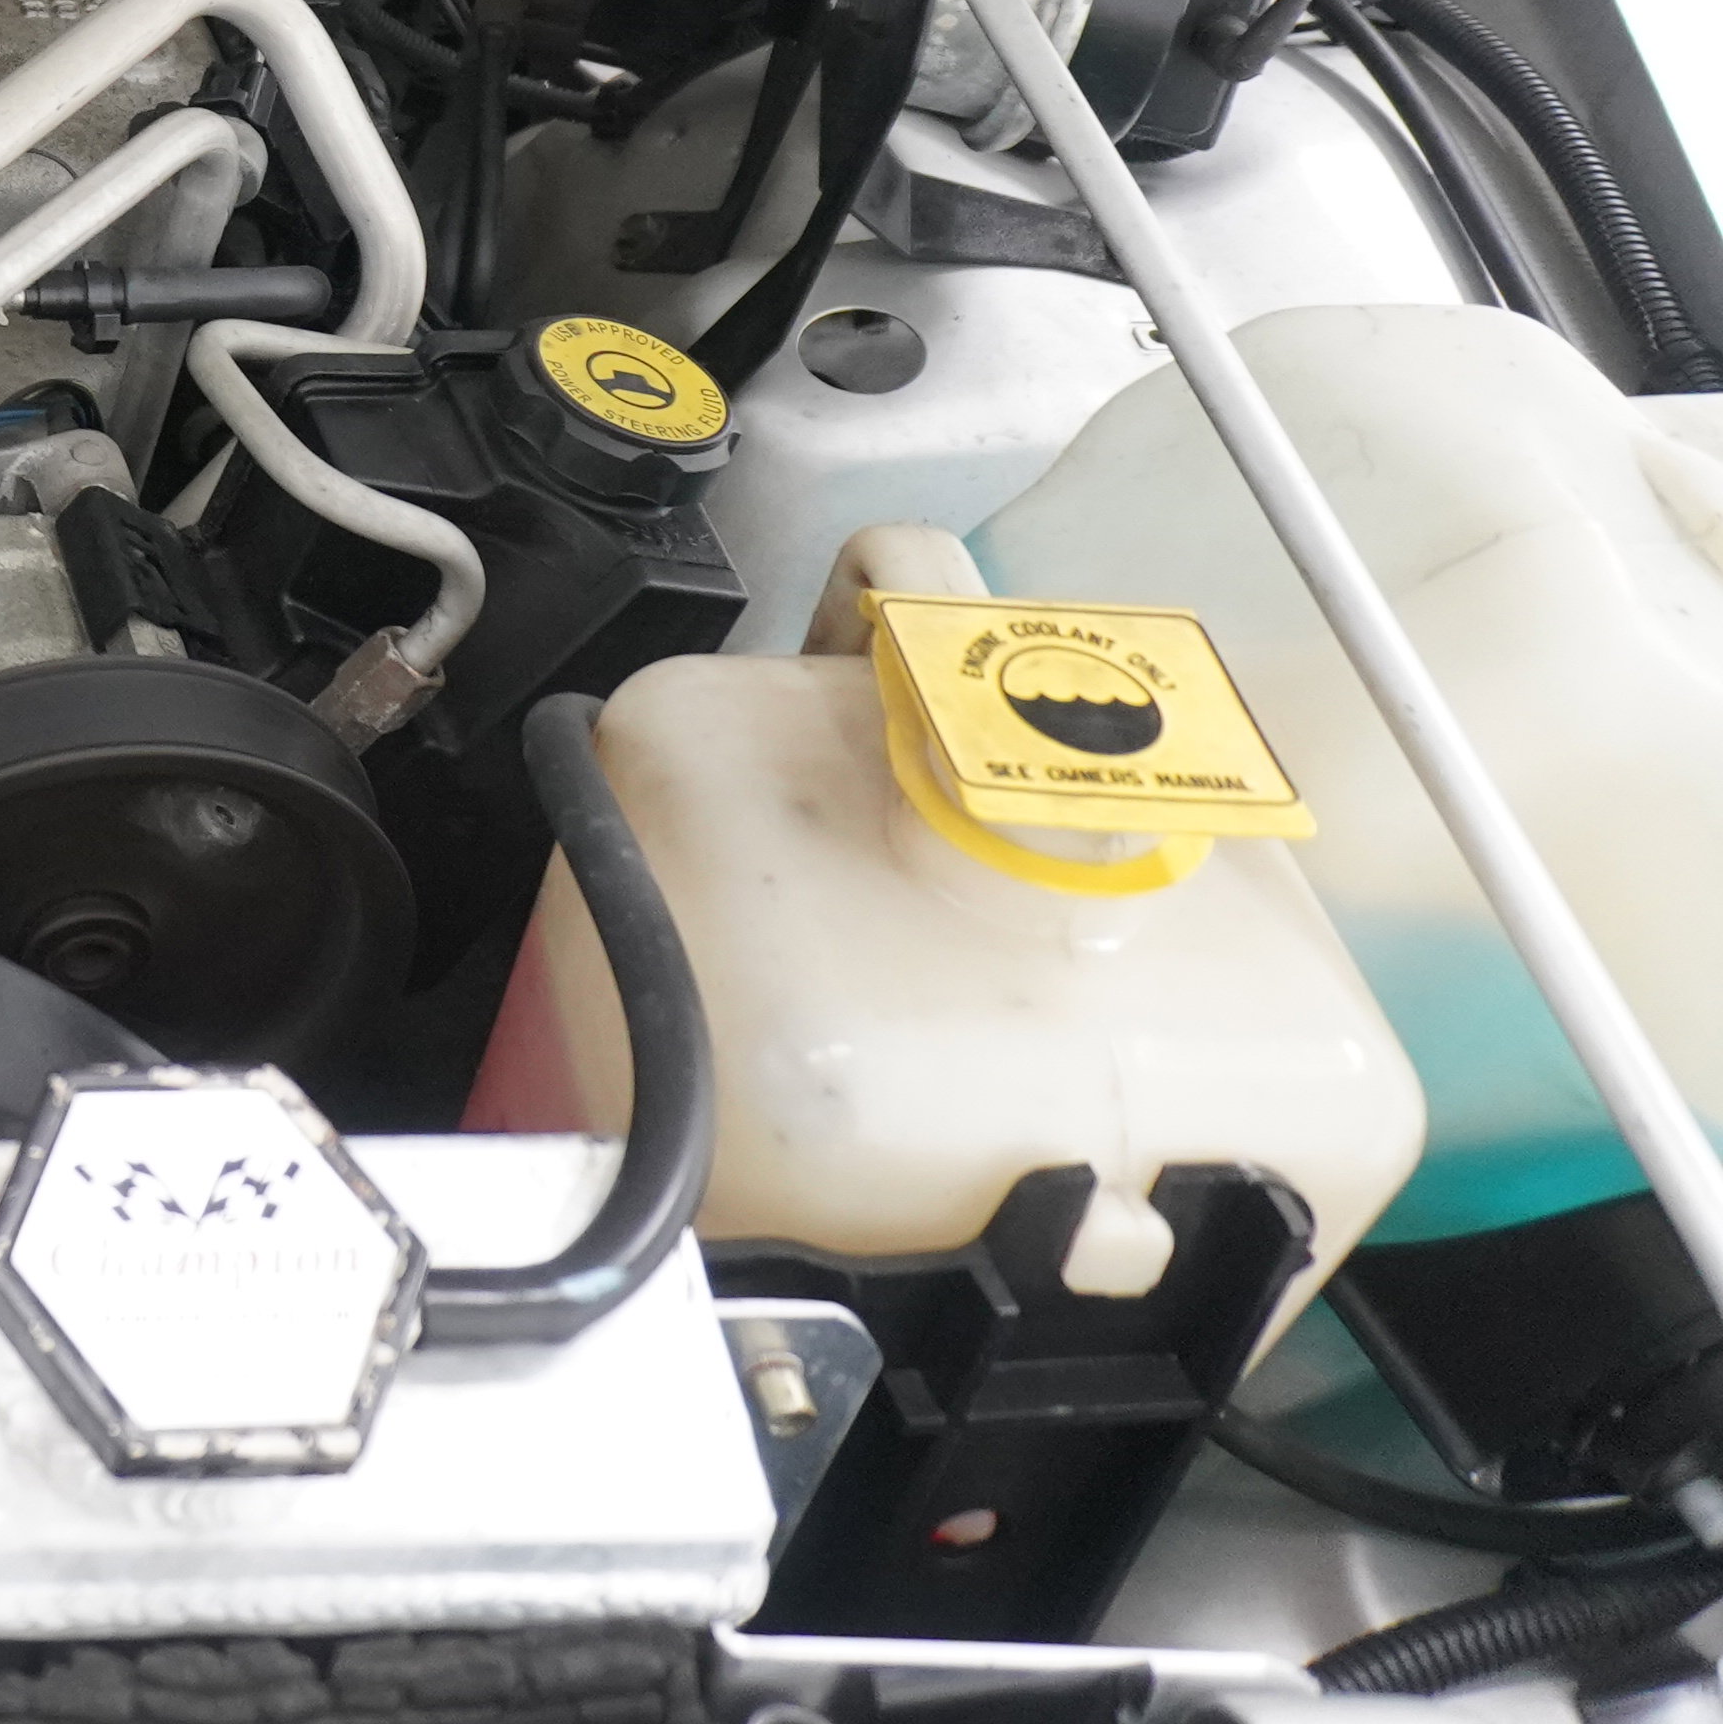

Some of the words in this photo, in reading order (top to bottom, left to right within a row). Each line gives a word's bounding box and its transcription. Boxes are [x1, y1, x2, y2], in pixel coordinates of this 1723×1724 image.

[550, 322, 580, 343] USE
[586, 321, 686, 366] APPROVED
[546, 359, 593, 404] POWER
[603, 408, 701, 439] STEERING
[698, 387, 722, 429] FLUID
[960, 629, 1007, 681] ENGINE
[1007, 620, 1116, 652] COOLANT
[1126, 650, 1178, 693] ONLY
[985, 760, 1033, 782] SEE
[1044, 765, 1144, 788] OWNERS
[1154, 772, 1252, 793] MANUAL
